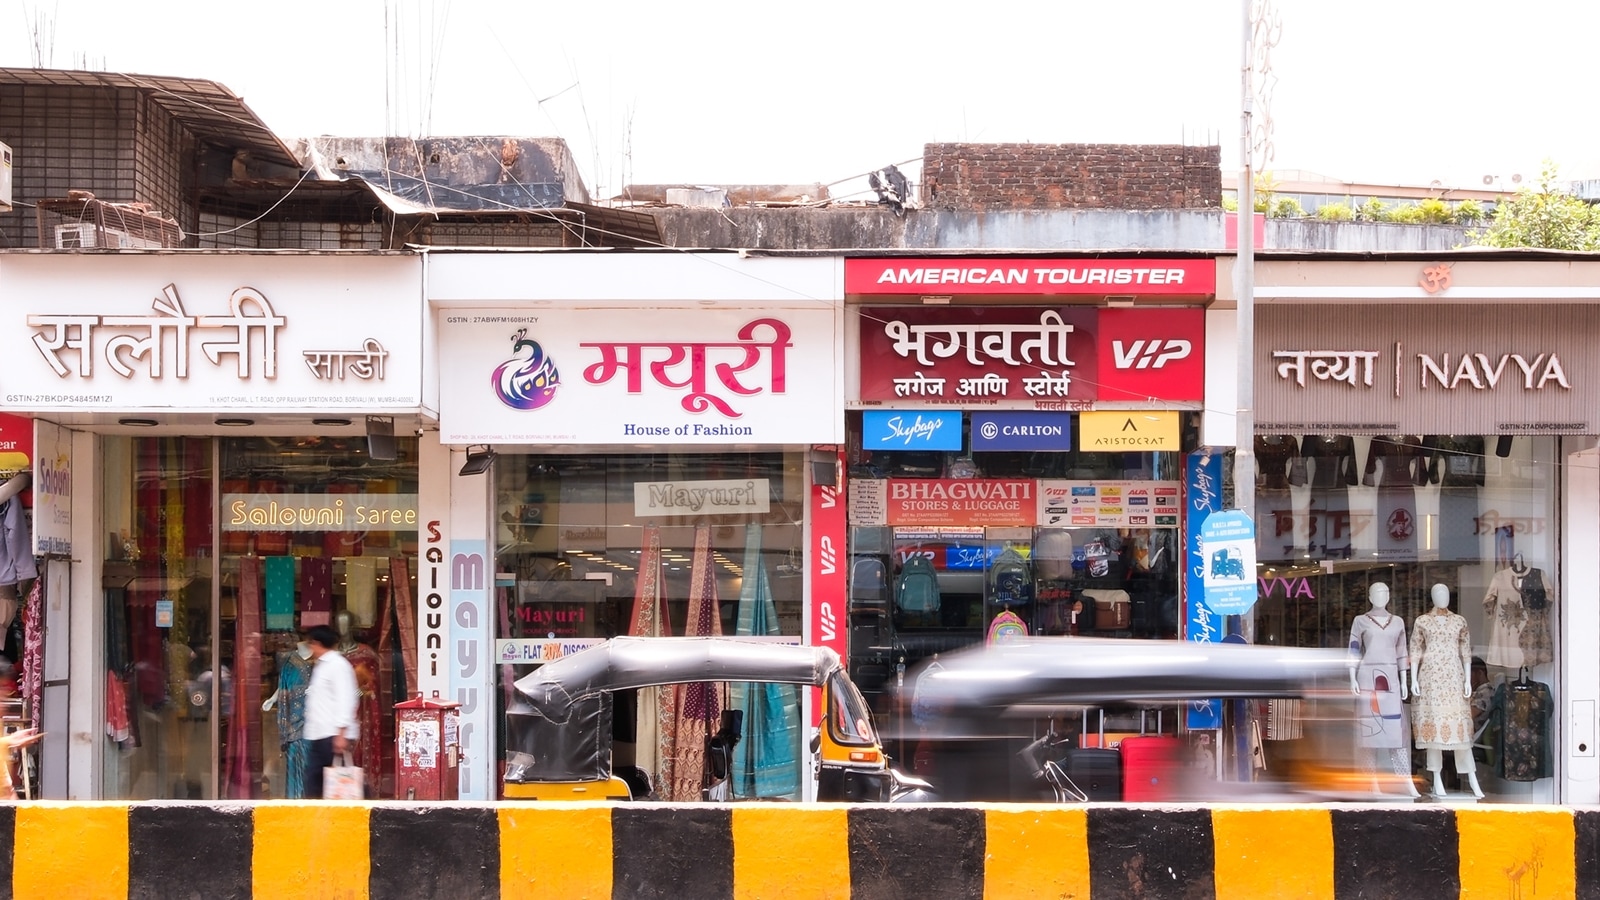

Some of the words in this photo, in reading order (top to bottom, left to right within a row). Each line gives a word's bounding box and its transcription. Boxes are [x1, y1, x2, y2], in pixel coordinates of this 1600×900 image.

[877, 268, 1031, 284] AMERICAN
[1034, 268, 1185, 284] TOURISTER
[27, 283, 287, 379] सलौनी
[884, 309, 1075, 367] भगवती
[302, 338, 389, 379] साडी
[1111, 339, 1192, 369] VIP
[579, 317, 793, 419] मयूरी
[1272, 350, 1379, 389] नव्या
[1417, 352, 1572, 389] NAVYA
[893, 371, 946, 397] लगेज
[955, 372, 1009, 397] आणि
[1023, 370, 1071, 397] स्टोर्स
[1034, 399, 1067, 411] भगवती
[624, 424, 670, 436] House
[674, 424, 689, 436] of
[693, 424, 753, 436] Fashion
[881, 416, 943, 442] Skybags
[1002, 424, 1062, 436] CARLTON
[1095, 437, 1165, 445] ARISTOCRAT
[648, 481, 756, 512] Mayuri
[892, 482, 1030, 500] BHAGWATI
[1194, 467, 1216, 513] Skybags
[231, 499, 344, 526] Salouni
[901, 501, 948, 510] STORES
[952, 501, 961, 510] &
[965, 501, 1020, 510] LUGGAGE
[821, 535, 836, 575] VIP
[901, 551, 935, 564] VP
[426, 520, 443, 677] Salouni
[1258, 577, 1316, 599] VYA
[516, 606, 586, 625] Mayuri
[821, 602, 836, 642] VIP
[523, 645, 542, 659] FLAT
[543, 643, 563, 661] 20%
